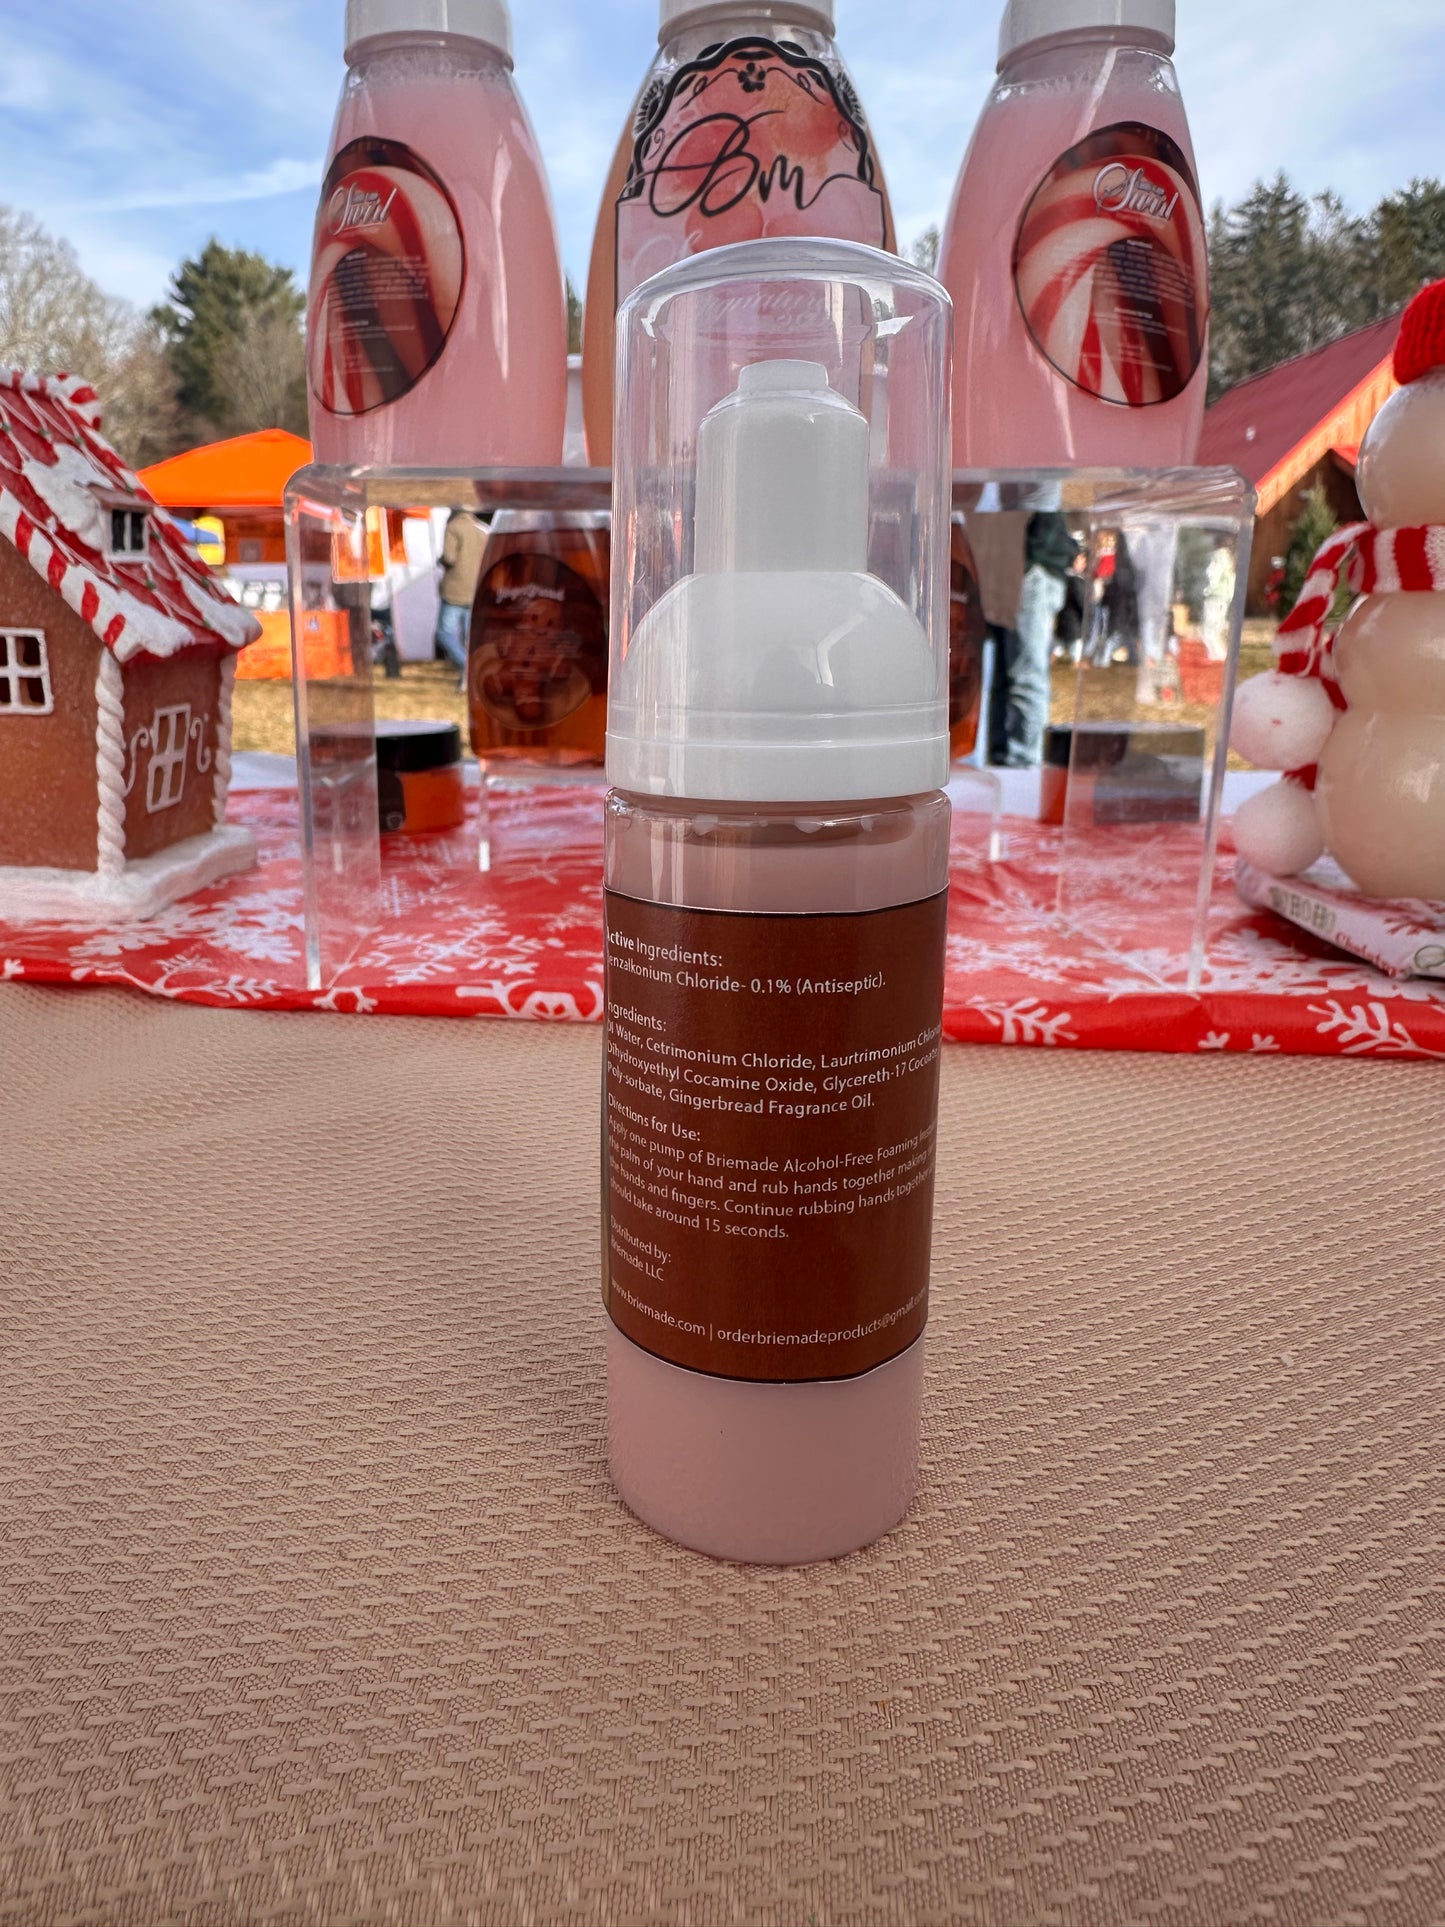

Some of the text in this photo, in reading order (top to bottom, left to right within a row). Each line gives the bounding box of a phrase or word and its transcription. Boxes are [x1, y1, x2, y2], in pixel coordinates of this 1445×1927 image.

[608, 955, 886, 996] enzalkonium Chloride- 0.1% (Antiseptic).
[637, 937, 722, 967] Ingredients:
[608, 1001, 667, 1032] ngredients:
[607, 1040, 679, 1083] Dihydroxyethyl
[684, 1069, 760, 1091] Cocamine
[766, 1078, 817, 1095] Oxide,
[823, 1062, 907, 1095] Glycereth-17
[615, 1023, 644, 1049] Water,
[646, 1037, 737, 1067] Cetrimonium
[741, 1053, 816, 1071] Chloride,
[821, 1040, 916, 1069] Laurtrimonium
[608, 1061, 875, 1119] Poly-sorbate, Gingerbread Fragrance Oil.
[608, 1092, 701, 1141] Directions for Use:
[608, 1114, 628, 1140] Apply
[629, 1131, 647, 1147] one
[650, 1141, 685, 1162] pump
[688, 1150, 703, 1164] of
[706, 1153, 779, 1172] Briemade
[783, 1153, 873, 1173] Alcohol-Free
[877, 1136, 918, 1161] Foaming
[620, 1146, 640, 1165] palm
[643, 1158, 654, 1172] of
[656, 1164, 684, 1180] your
[688, 1169, 723, 1189] hand
[729, 1178, 757, 1193] and
[762, 1180, 789, 1195] rub
[794, 1176, 838, 1195] hands
[843, 1169, 895, 1190] together
[620, 1164, 645, 1189] hands
[647, 1183, 668, 1203] and
[672, 1187, 721, 1211] fingers.
[724, 1199, 794, 1217] Continue
[799, 1196, 855, 1217] rubbing
[858, 1187, 895, 1208] hands
[633, 1194, 654, 1214] take
[656, 1207, 700, 1229] around
[704, 1218, 721, 1233] 15
[725, 1220, 789, 1239] seconds.
[645, 1262, 664, 1281] LLC
[654, 1244, 671, 1265] by:
